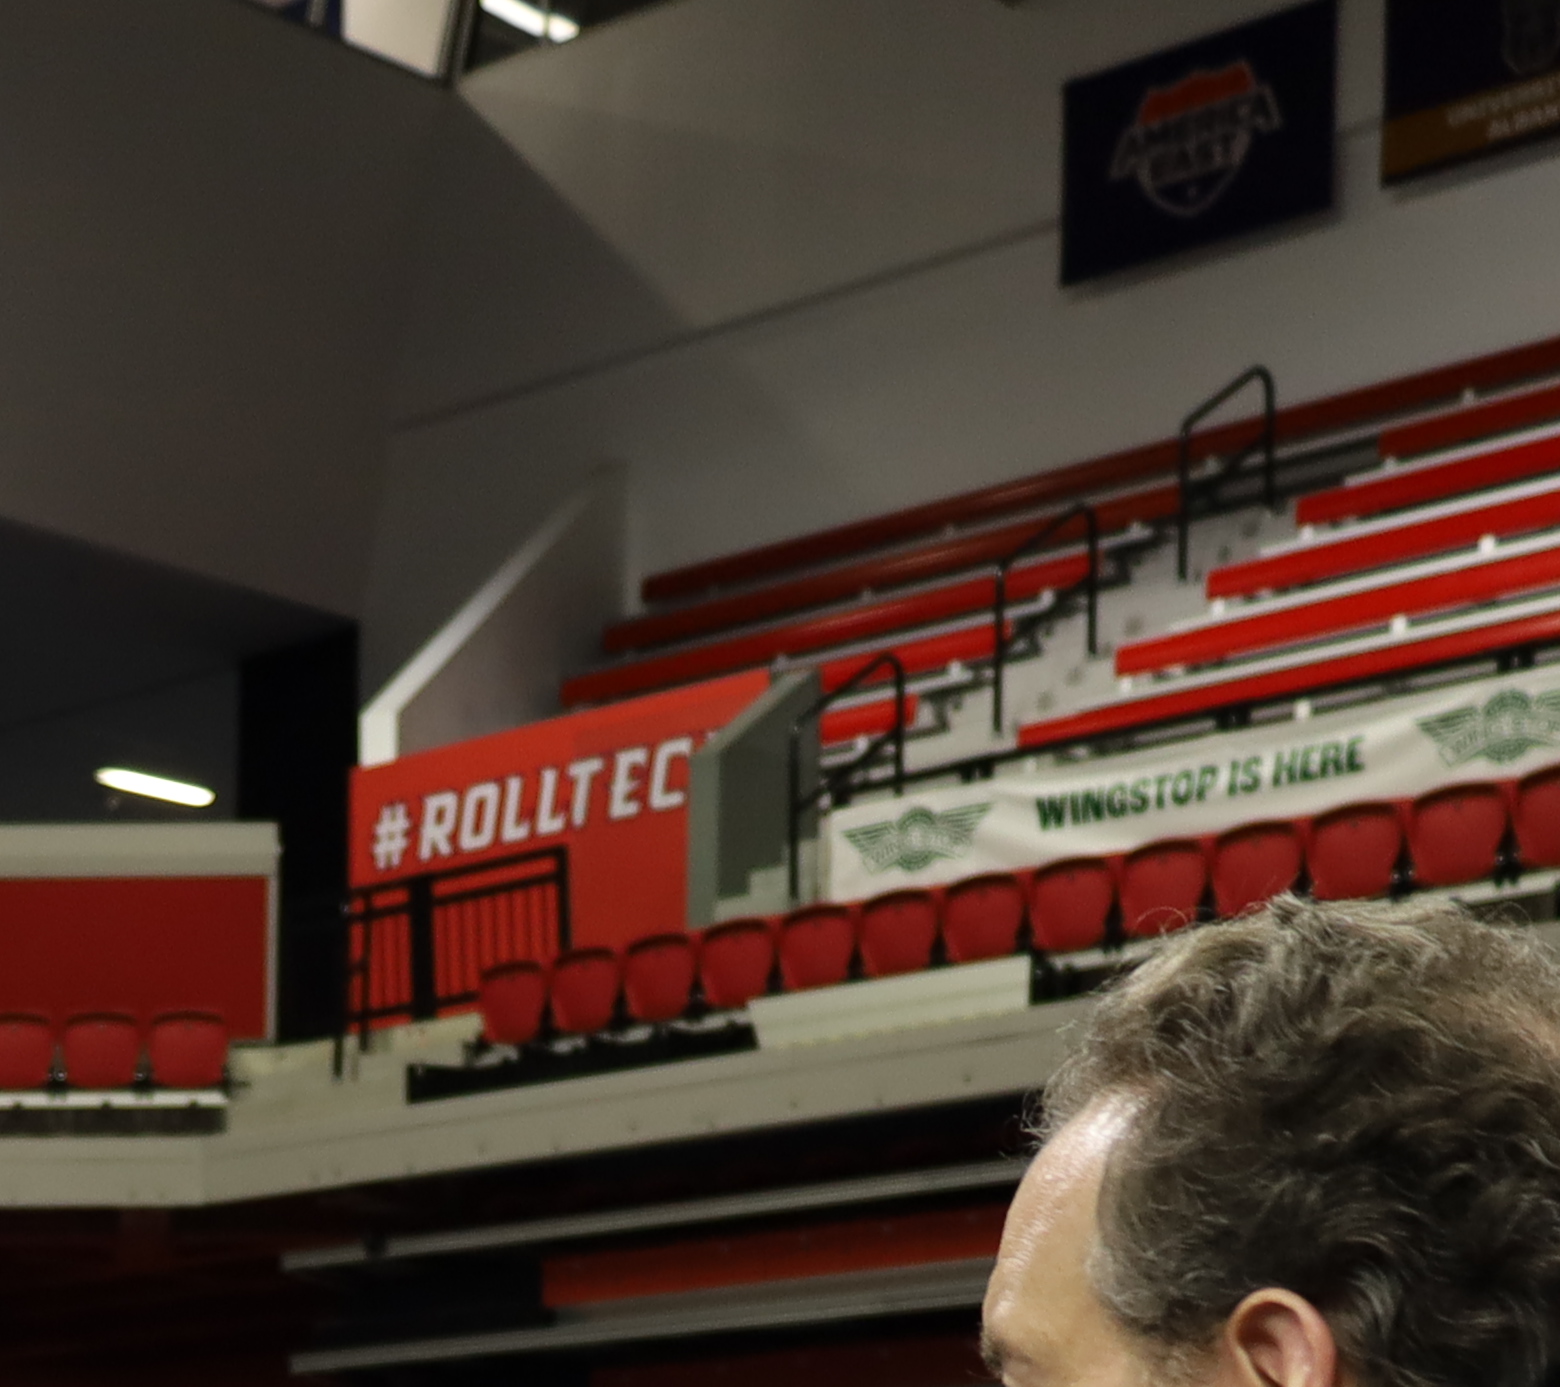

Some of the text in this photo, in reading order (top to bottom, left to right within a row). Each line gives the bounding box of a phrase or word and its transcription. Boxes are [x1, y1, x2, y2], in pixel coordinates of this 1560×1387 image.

[374, 736, 692, 870] #ROLLTEC
[1036, 736, 1365, 831] WINGSTOP IS HERE
